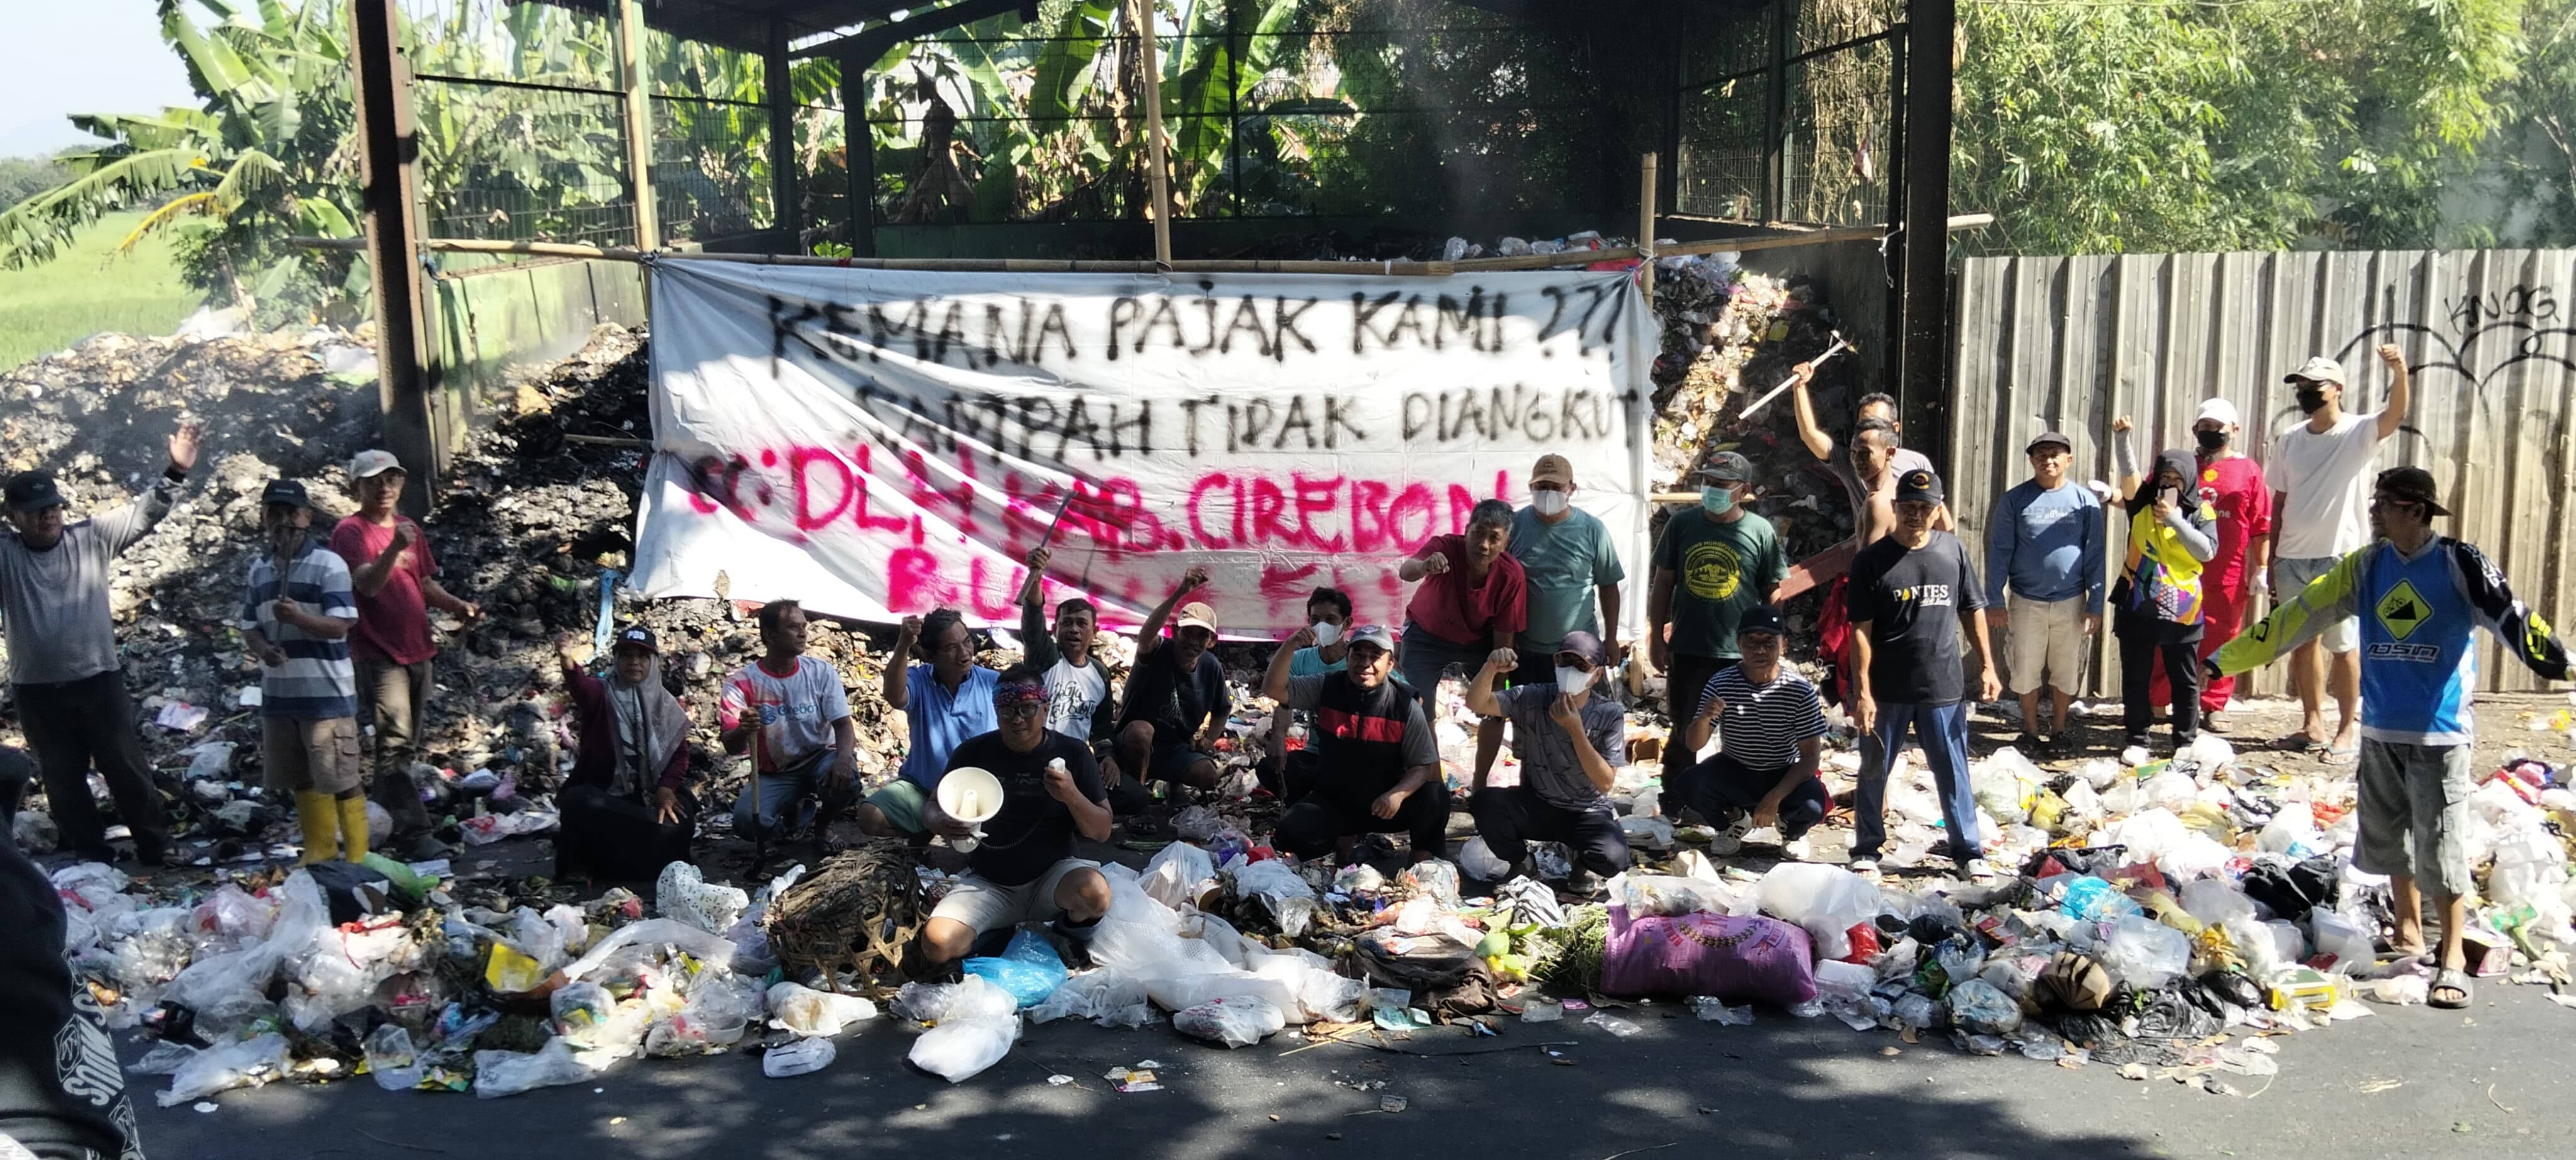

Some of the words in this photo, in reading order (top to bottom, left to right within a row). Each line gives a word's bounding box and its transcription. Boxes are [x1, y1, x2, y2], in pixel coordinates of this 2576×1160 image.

[767, 294, 1077, 379] KEMANA
[1107, 281, 1318, 363] PAJAK
[1351, 286, 1507, 354] KAMI
[852, 382, 1153, 464] SAMPAH
[1180, 394, 1367, 457] TIDAK
[1401, 384, 1638, 449] DIANGKUT
